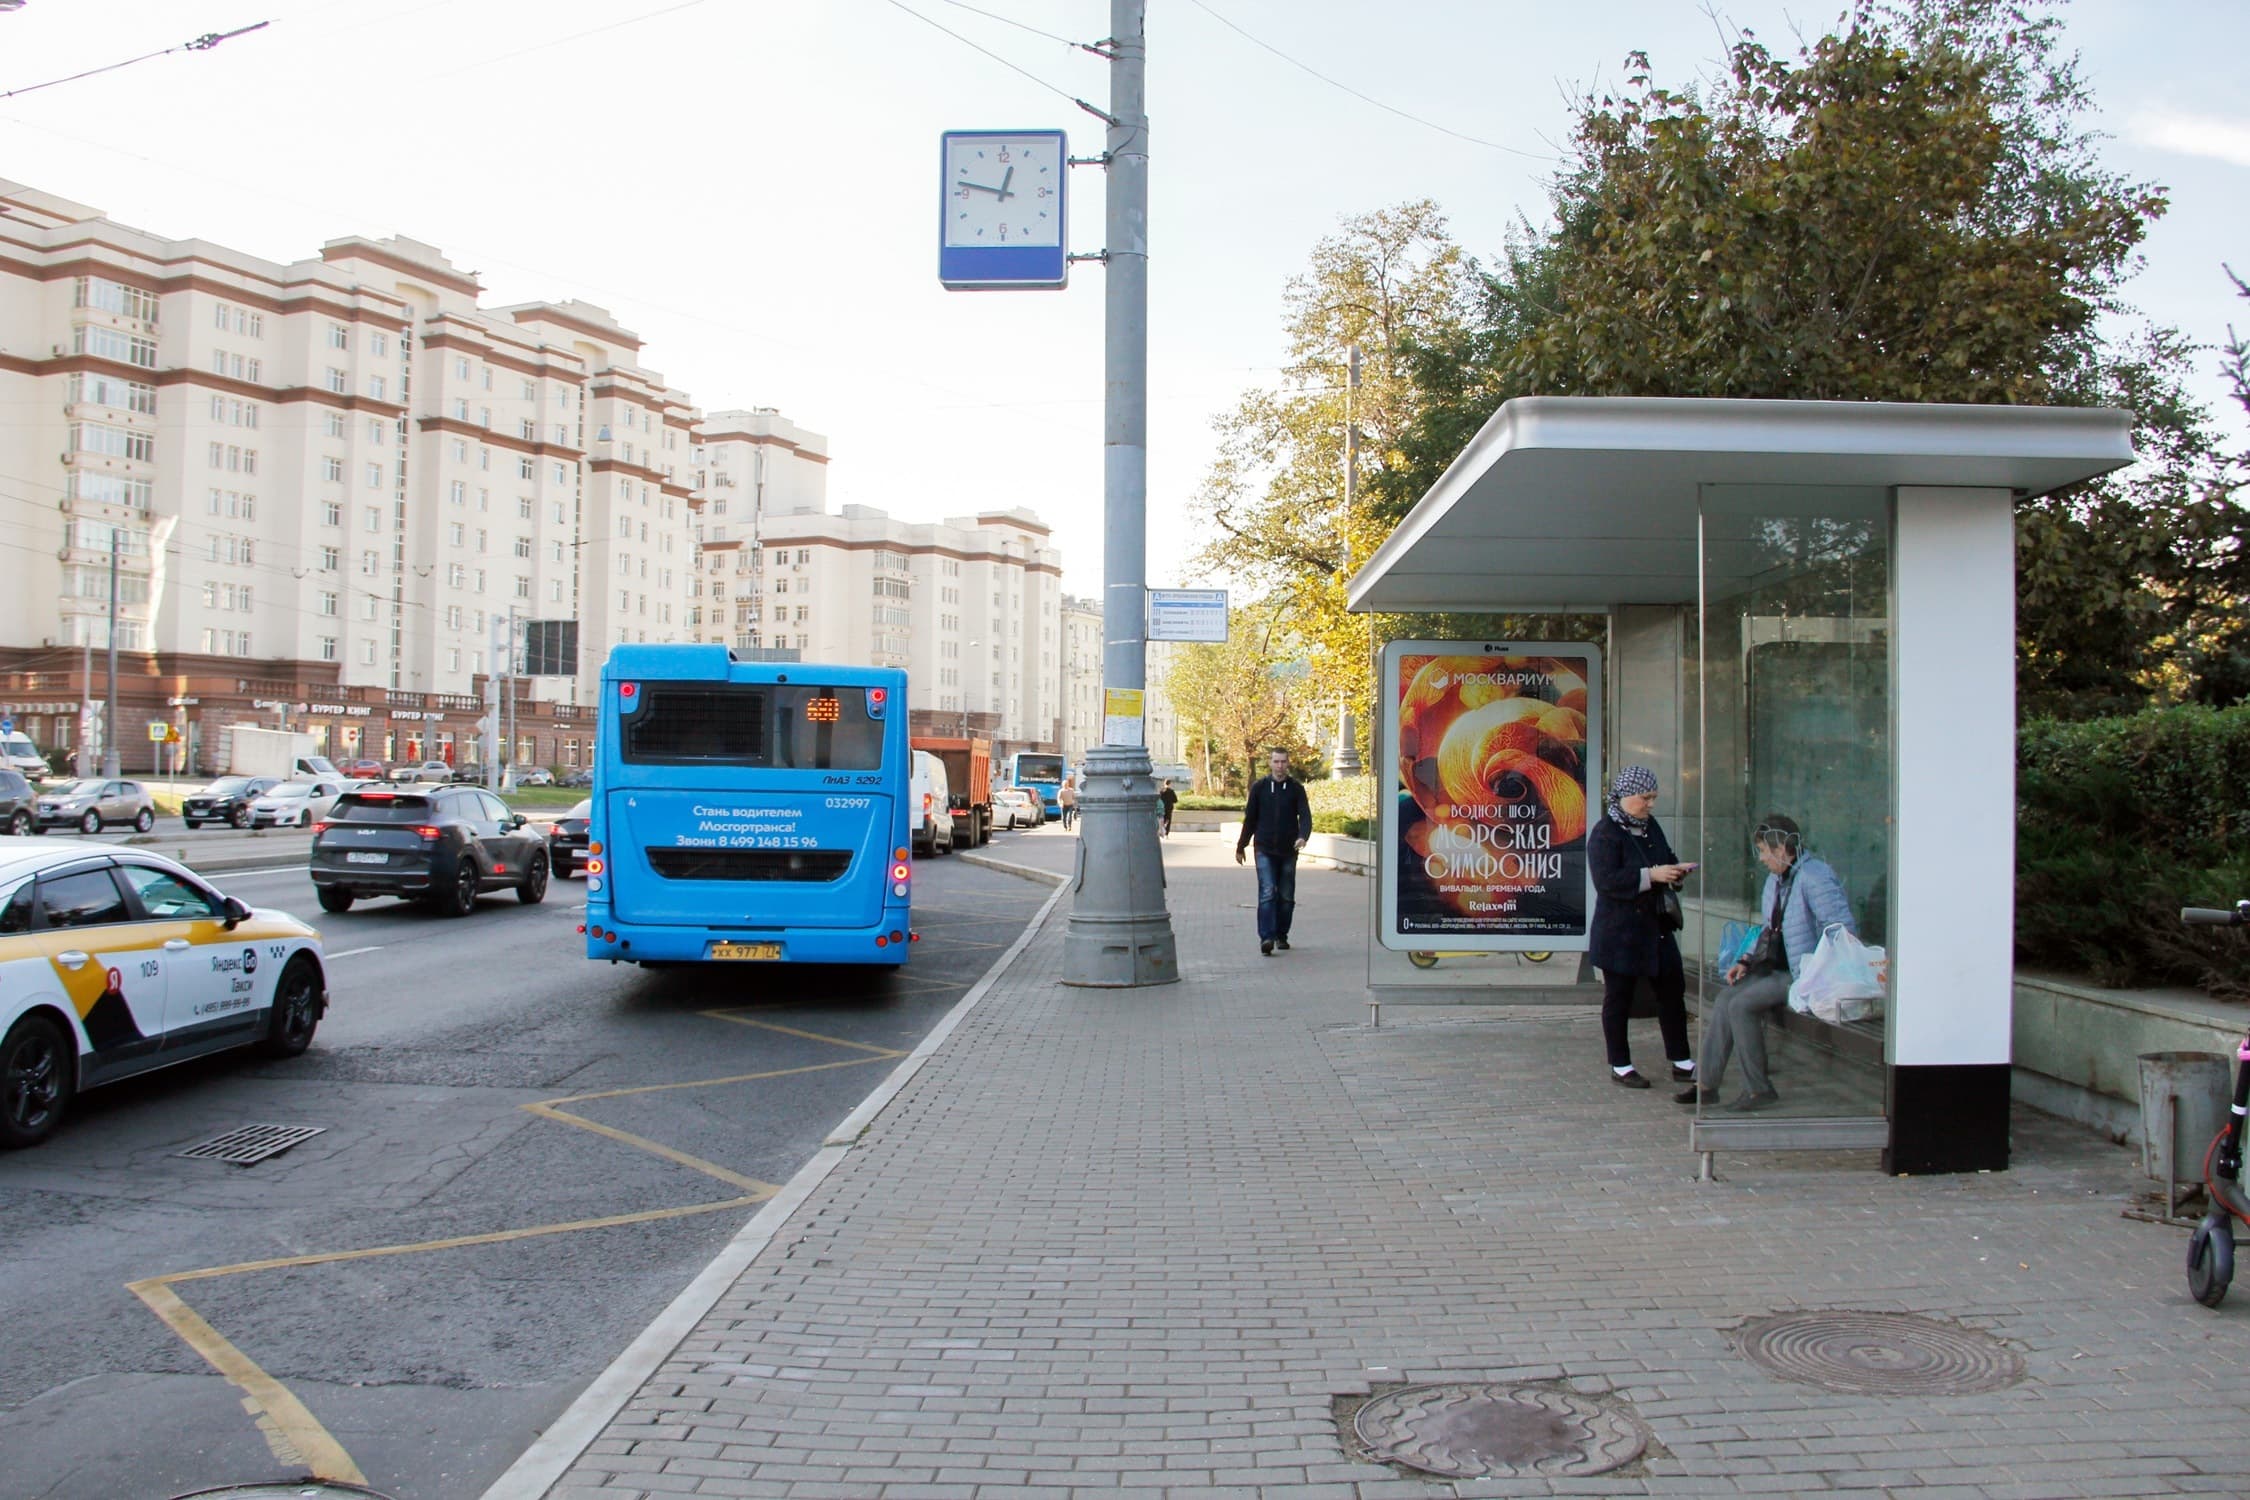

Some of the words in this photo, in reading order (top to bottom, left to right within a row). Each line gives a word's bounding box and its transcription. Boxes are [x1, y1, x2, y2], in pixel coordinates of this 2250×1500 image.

[998, 152, 1010, 163] 12
[962, 188, 970, 200] 9
[1038, 187, 1046, 198] 3
[1000, 223, 1008, 234] 6
[1453, 673, 1557, 686] МОСКВАРИУМ
[311, 704, 345, 715] БУРГЕР
[347, 706, 372, 716] КИНГ
[391, 710, 422, 720] БУРГЕР
[856, 776, 883, 785] 5292
[825, 798, 870, 809] 032997
[693, 806, 730, 817] Стань
[732, 808, 802, 819] водителем
[1451, 804, 1502, 820] ВОДНОЕ
[1508, 804, 1537, 820] ШОУ
[699, 821, 796, 834] Мосгортранса!
[675, 835, 716, 847] Звони
[718, 837, 728, 847] 8
[730, 837, 755, 847] 499
[757, 837, 780, 848] 148
[783, 838, 799, 848] 15
[801, 838, 818, 848] 96
[1435, 823, 1551, 850] МОРСКАЯ
[1424, 852, 1562, 879] СИМФОНИЯ
[1486, 885, 1522, 893] ВРЕМЕНА
[1524, 885, 1546, 893] ГОДА
[1403, 918, 1415, 930] 0+
[736, 946, 758, 957] 977
[140, 959, 159, 979] 109
[212, 956, 243, 973] Яндекс
[245, 953, 257, 967] Go
[110, 971, 119, 989] Я
[231, 977, 254, 993] Такси
